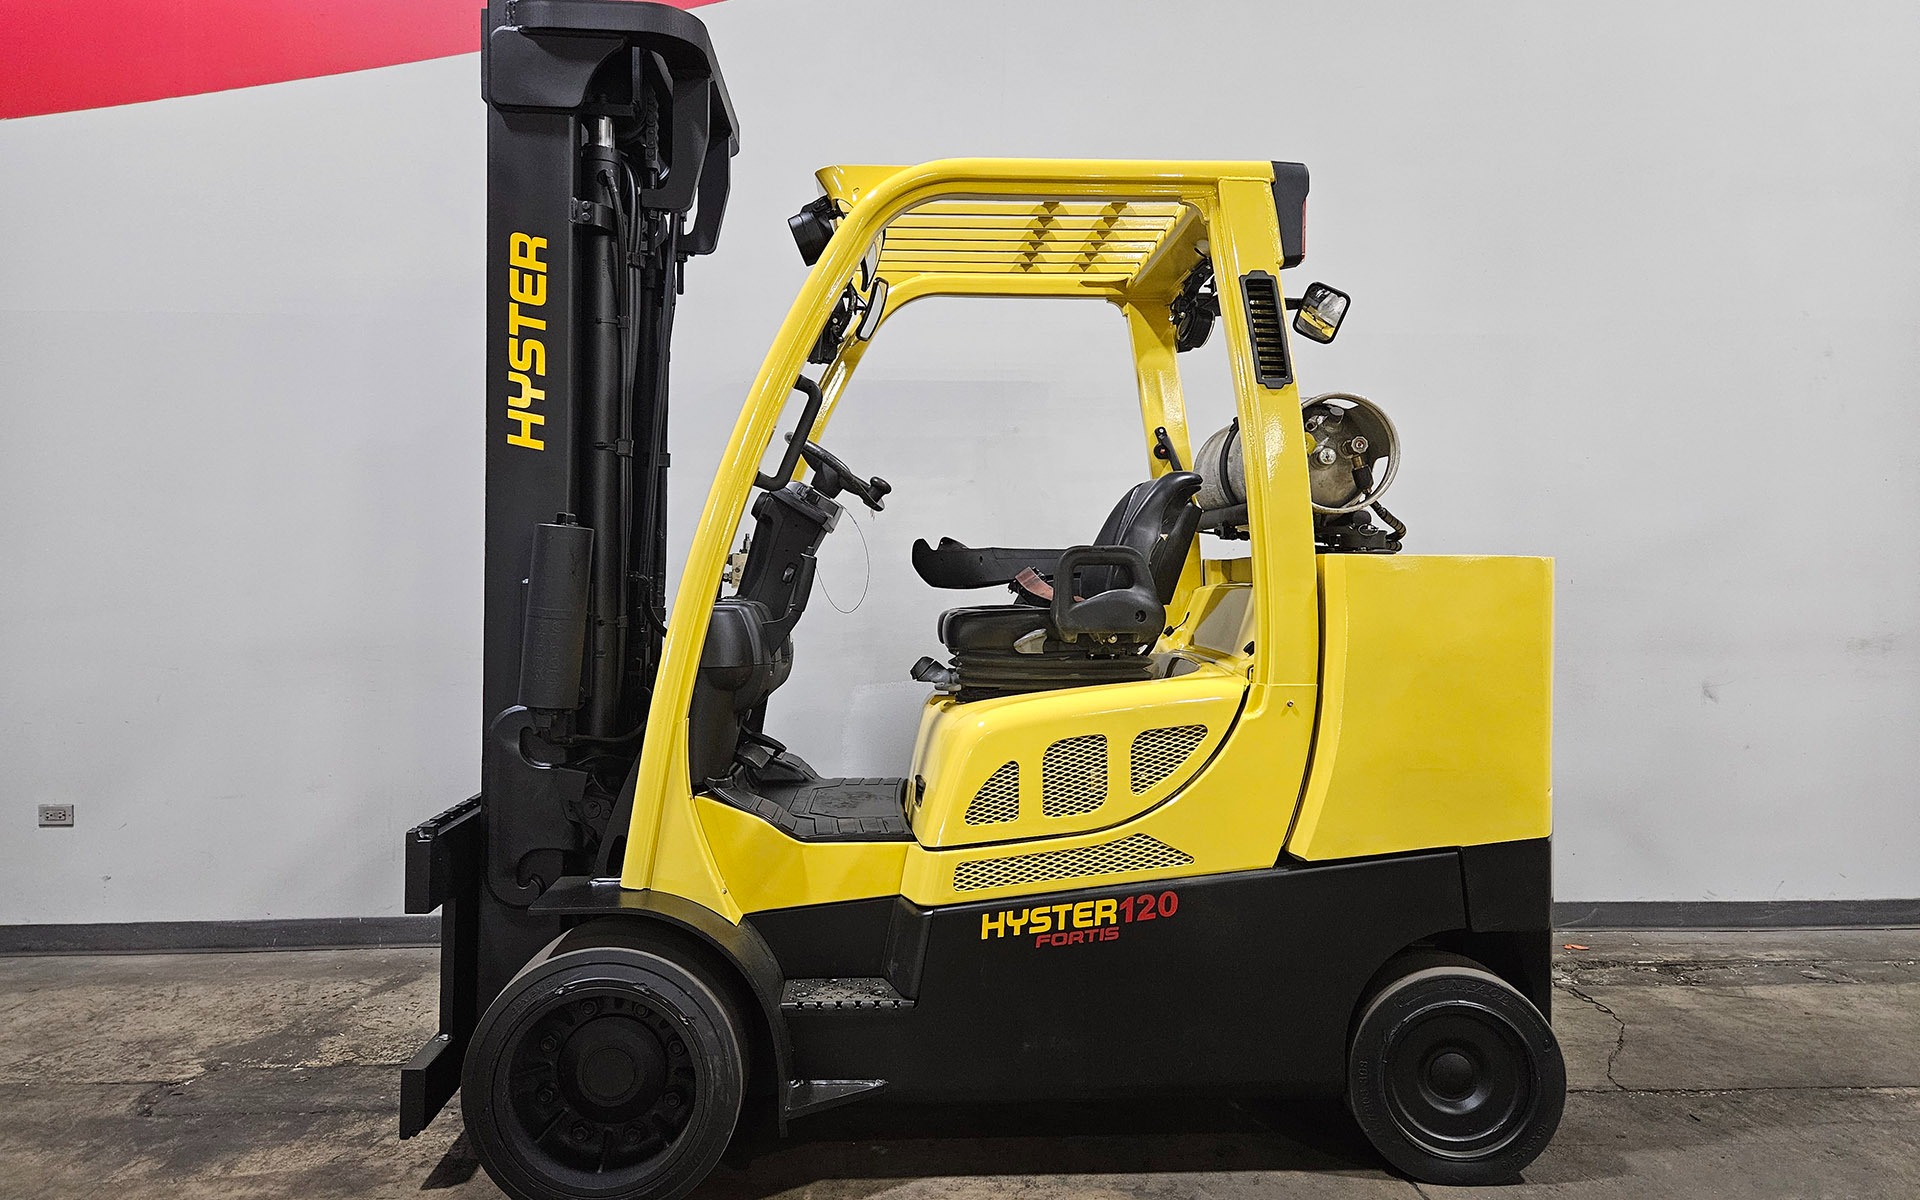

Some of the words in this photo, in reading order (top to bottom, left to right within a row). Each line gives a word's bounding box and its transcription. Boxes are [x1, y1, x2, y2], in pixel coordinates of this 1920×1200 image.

[507, 231, 548, 451] HYSTER
[981, 898, 1118, 940] HYSTER
[1119, 890, 1179, 923] 120
[1034, 926, 1120, 949] FORTIS
